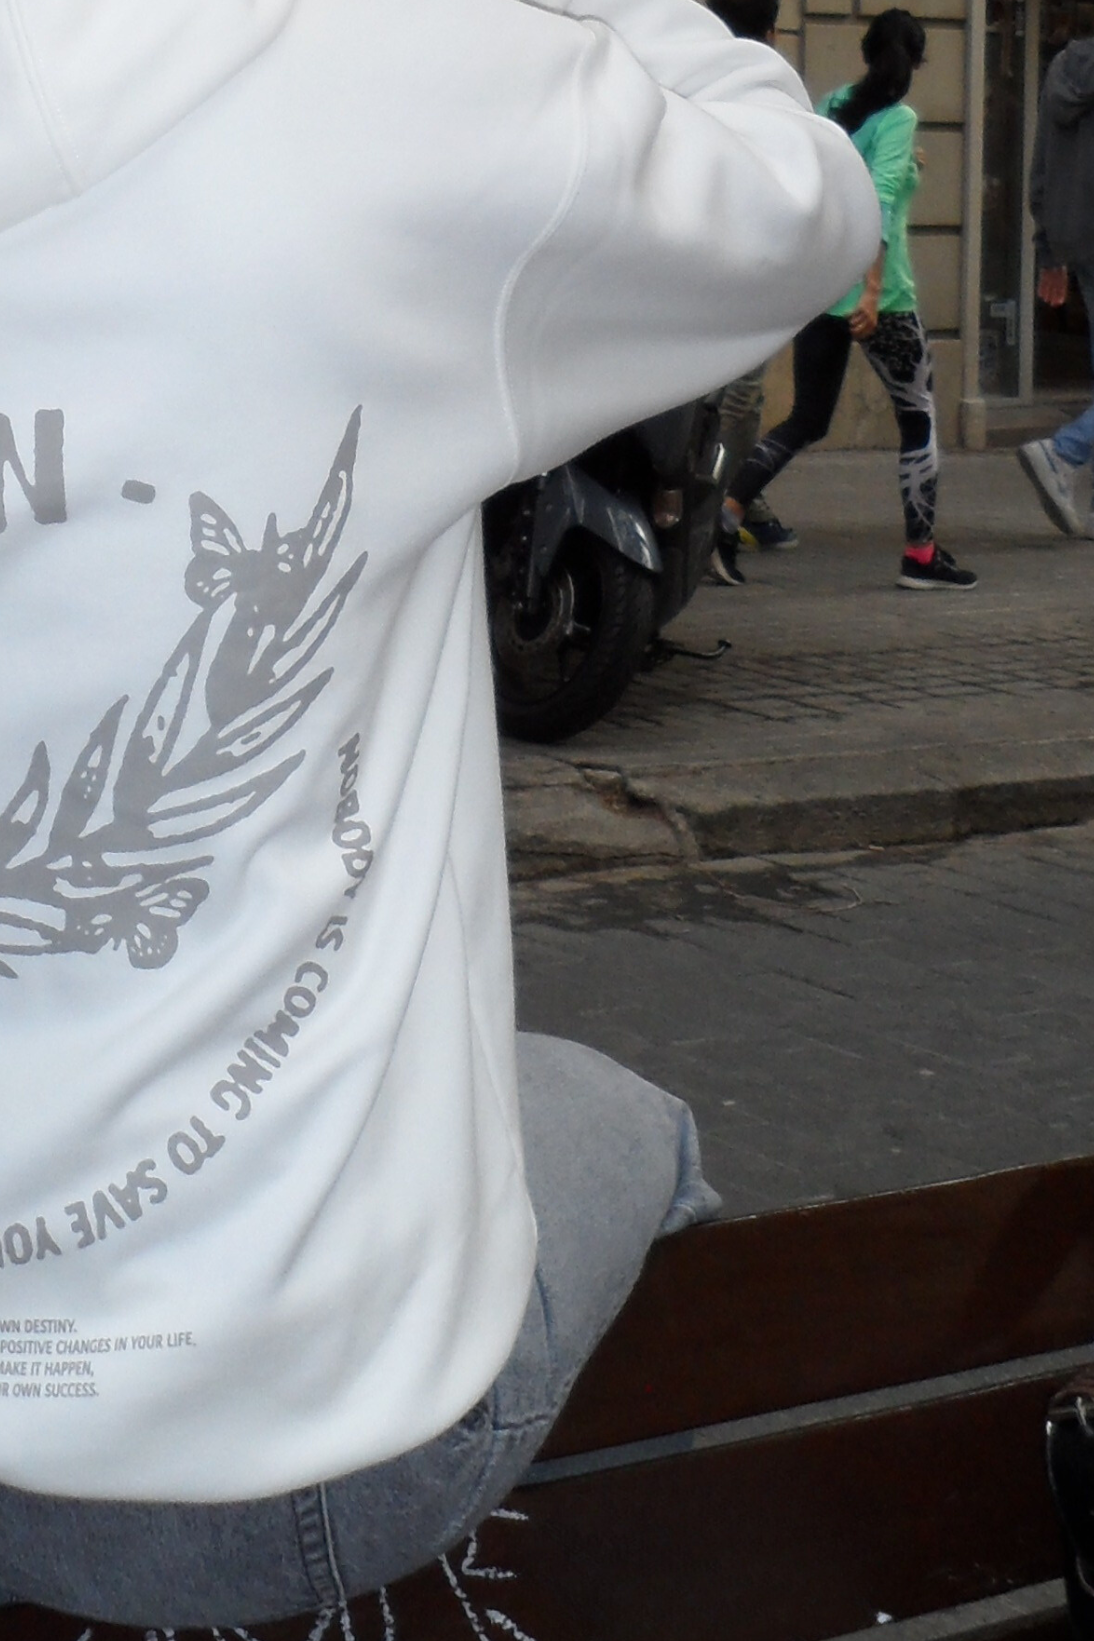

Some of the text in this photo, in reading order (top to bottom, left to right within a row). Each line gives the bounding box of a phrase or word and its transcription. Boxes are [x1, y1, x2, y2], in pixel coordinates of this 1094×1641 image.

[316, 916, 348, 952] IS
[210, 961, 329, 1120] COMING
[166, 1116, 226, 1175] TO
[64, 1159, 168, 1250] SAVE
[24, 1319, 77, 1334] DESTINY.
[0, 1340, 53, 1355] POSITIVE
[56, 1337, 112, 1355] CHANGES
[114, 1336, 127, 1350] IN
[131, 1334, 163, 1349] YOUR
[30, 1362, 41, 1376] IT
[12, 1383, 41, 1398] OWN
[44, 1382, 99, 1399] SUCCESS.
